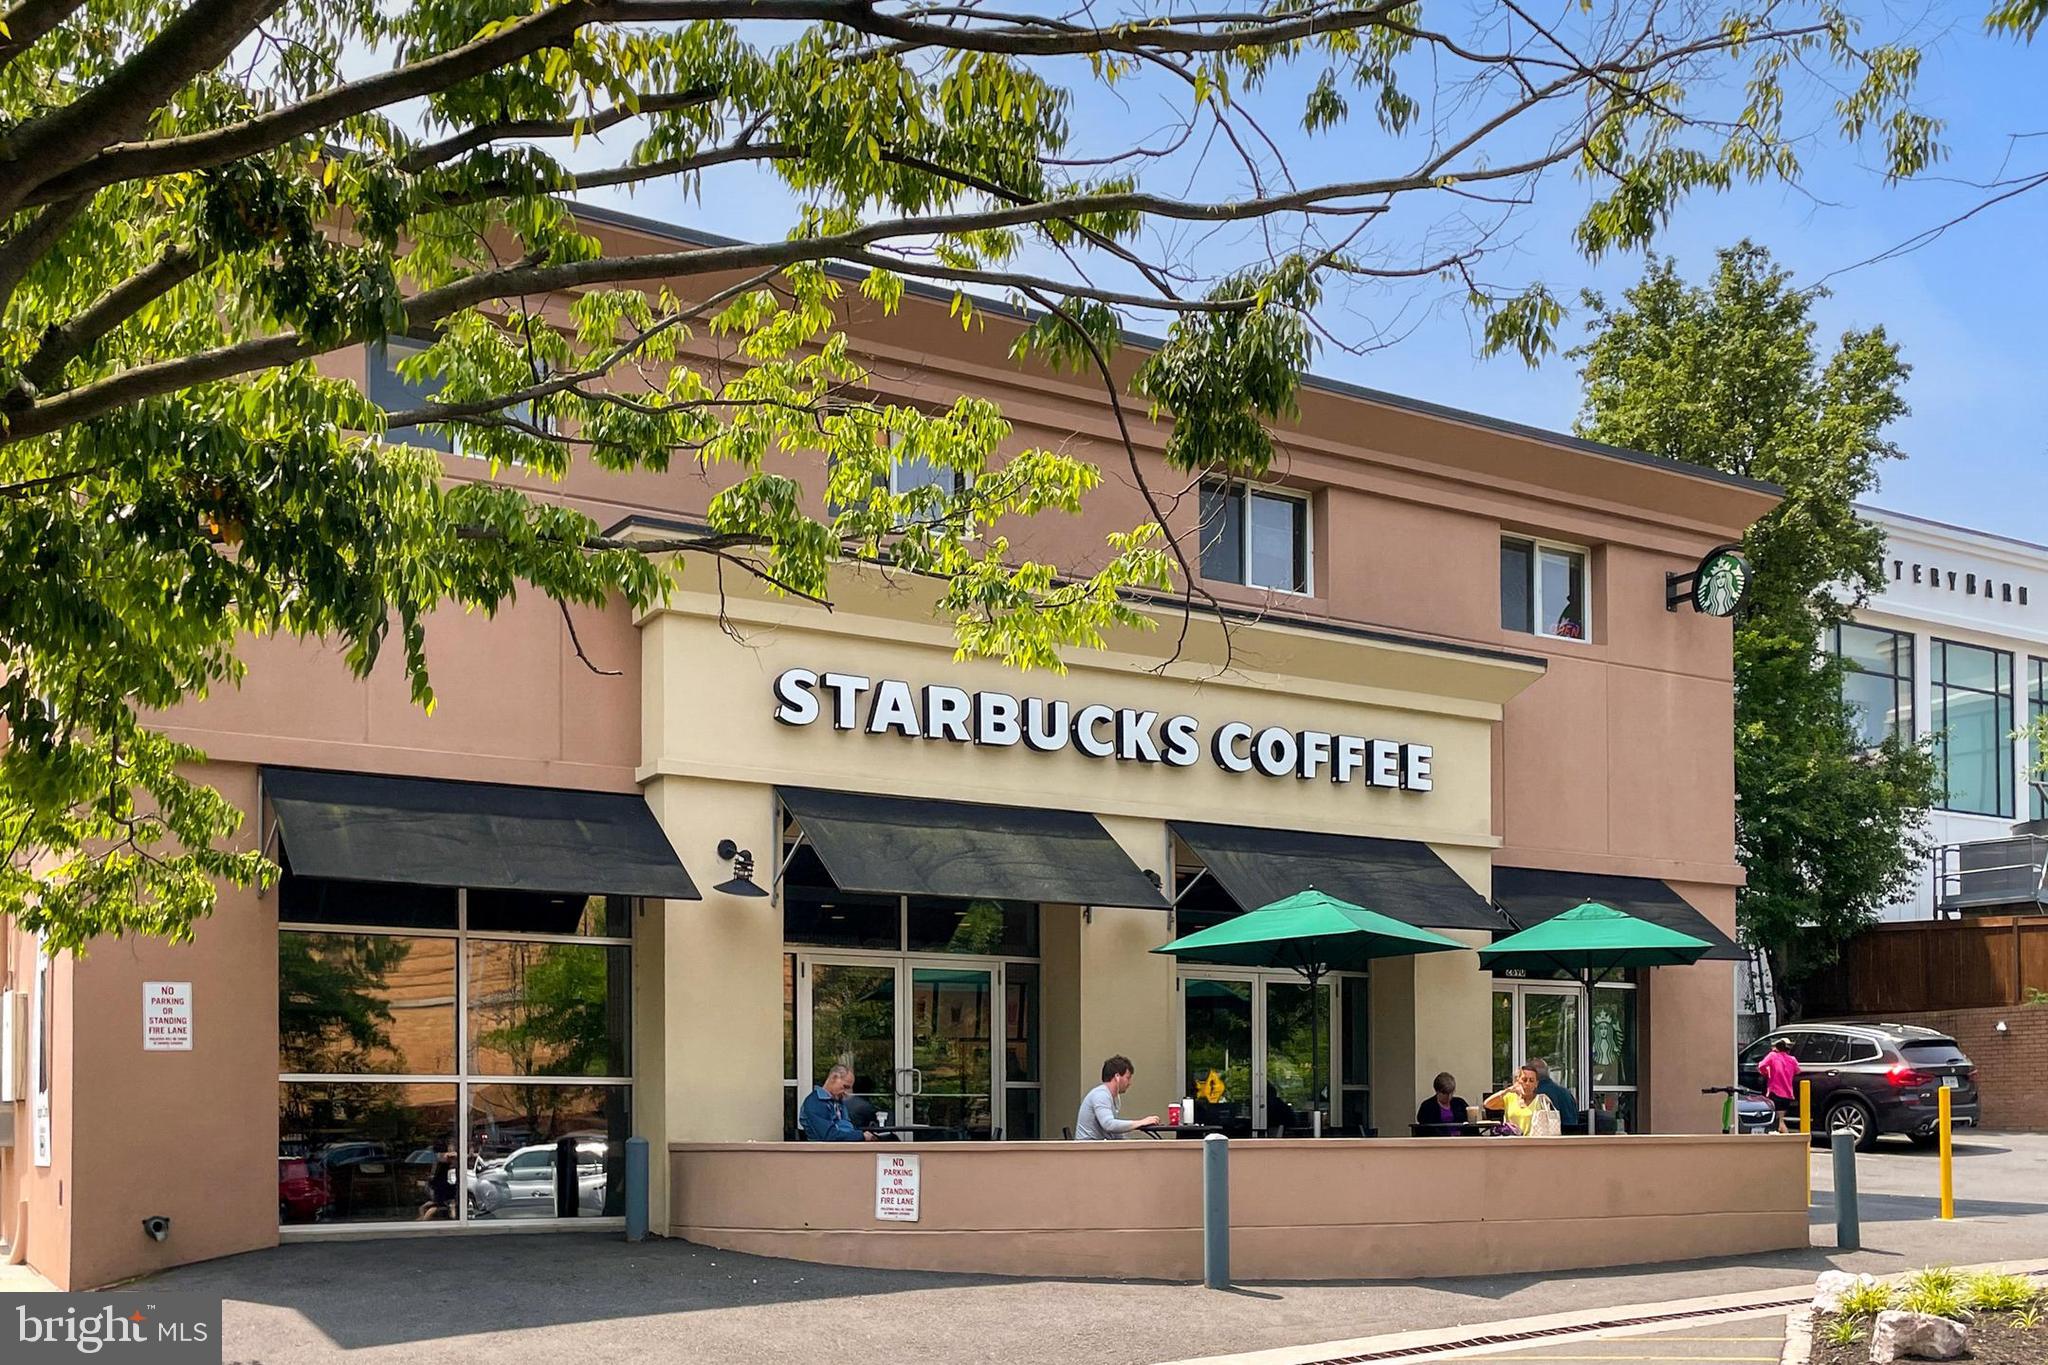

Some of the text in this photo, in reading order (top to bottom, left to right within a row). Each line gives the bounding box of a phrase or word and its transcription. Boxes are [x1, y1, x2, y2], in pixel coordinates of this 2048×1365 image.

[773, 667, 1433, 792] STARBUCKS COFFEE
[161, 986, 174, 996] NO
[162, 1007, 173, 1015] OR
[148, 1017, 187, 1025] STANDING
[148, 1027, 187, 1035] FIRE LANE
[892, 1158, 904, 1167] NO
[883, 1168, 913, 1177] PARKING
[893, 1178, 903, 1186] OR
[881, 1187, 915, 1196] STANDING
[880, 1197, 914, 1205] FIRE LANE
